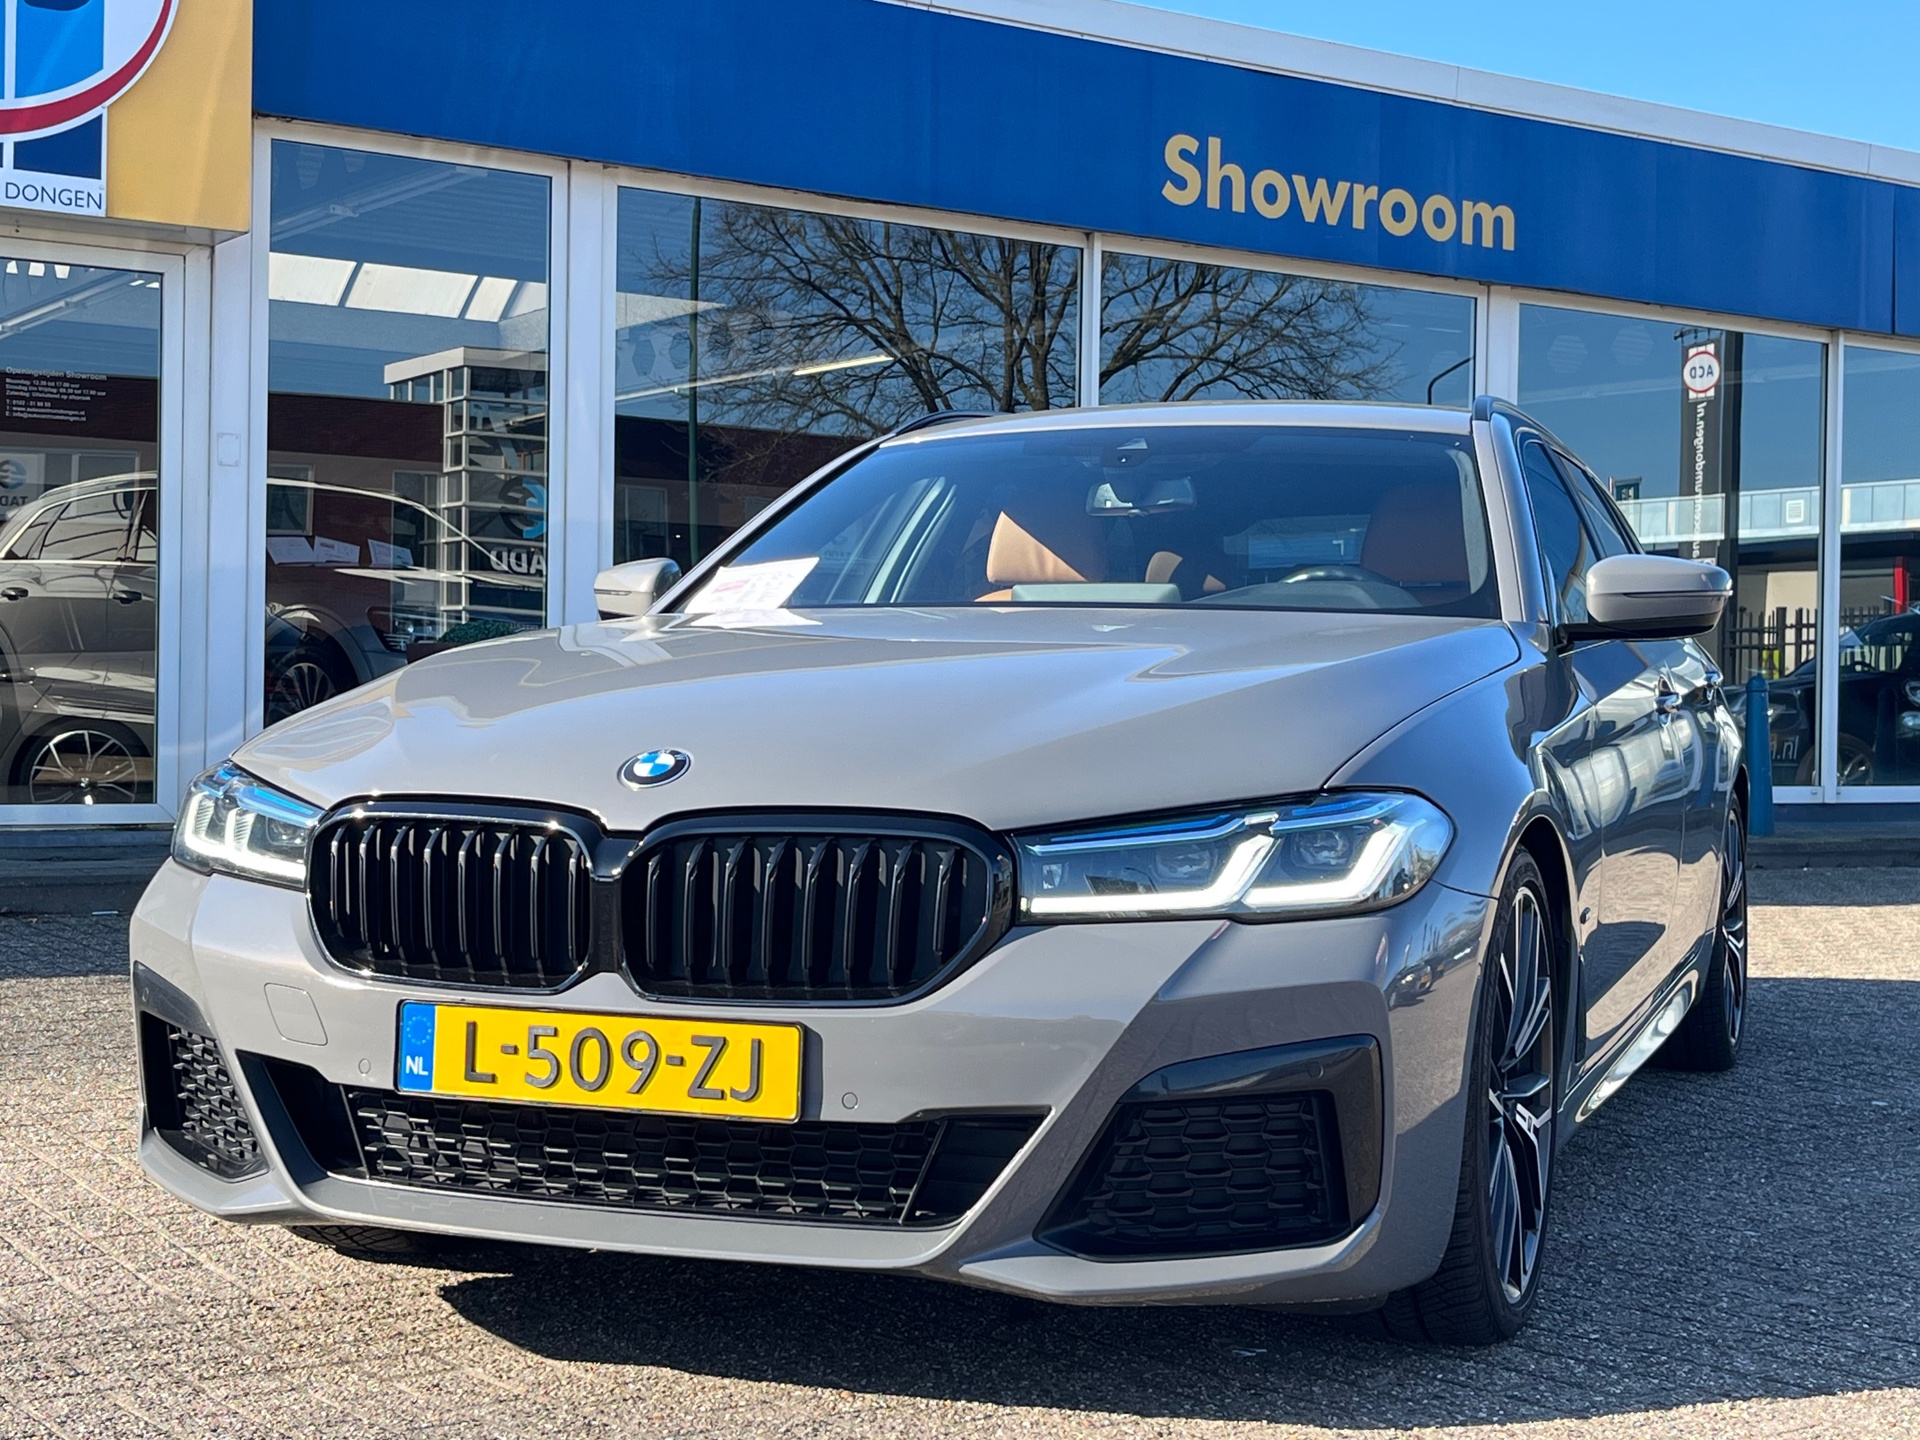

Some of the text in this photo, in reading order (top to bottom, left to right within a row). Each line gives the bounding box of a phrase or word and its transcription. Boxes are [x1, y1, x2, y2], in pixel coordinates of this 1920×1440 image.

[5, 181, 102, 210] DONGEN
[1161, 133, 1515, 251] Showroom
[66, 371, 107, 381] Showroom
[405, 1020, 763, 1102] NL L-509-ZJ
